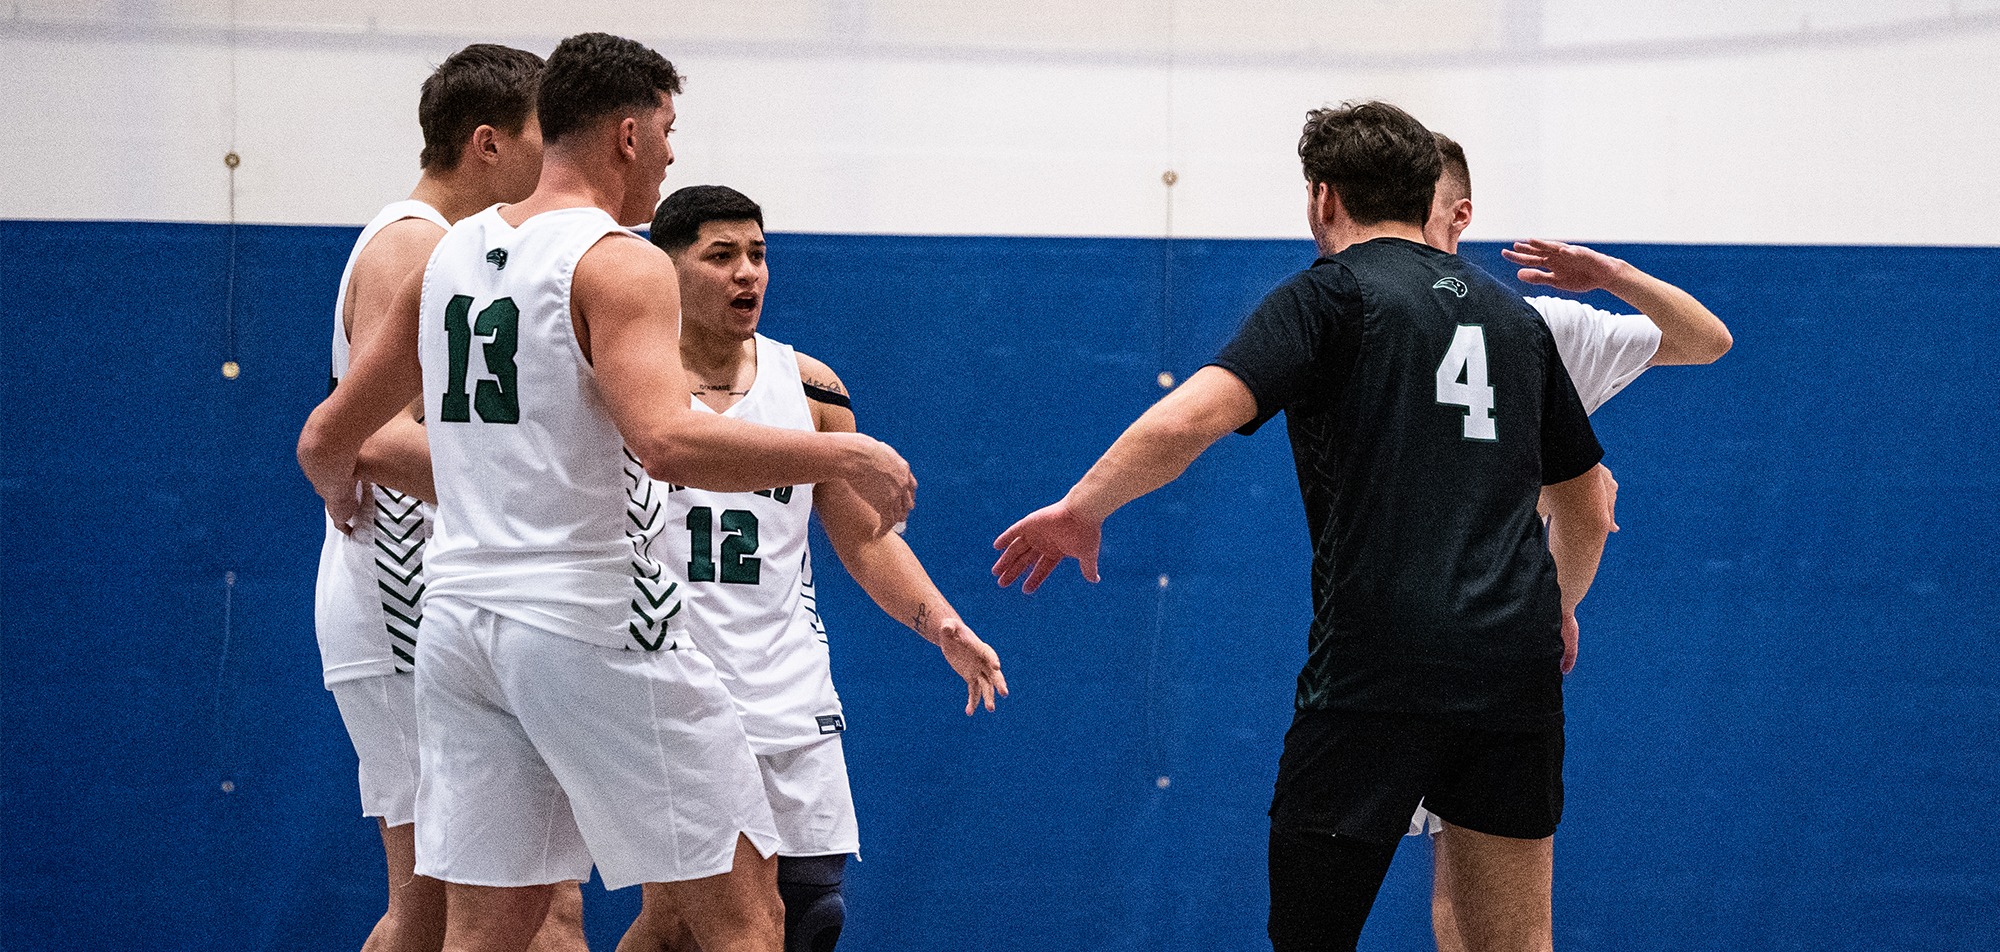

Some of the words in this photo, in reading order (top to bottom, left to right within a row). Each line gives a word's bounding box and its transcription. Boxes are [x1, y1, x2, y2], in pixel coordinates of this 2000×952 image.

[441, 294, 520, 424] 13
[1435, 323, 1499, 442] 4
[686, 506, 761, 585] 12
